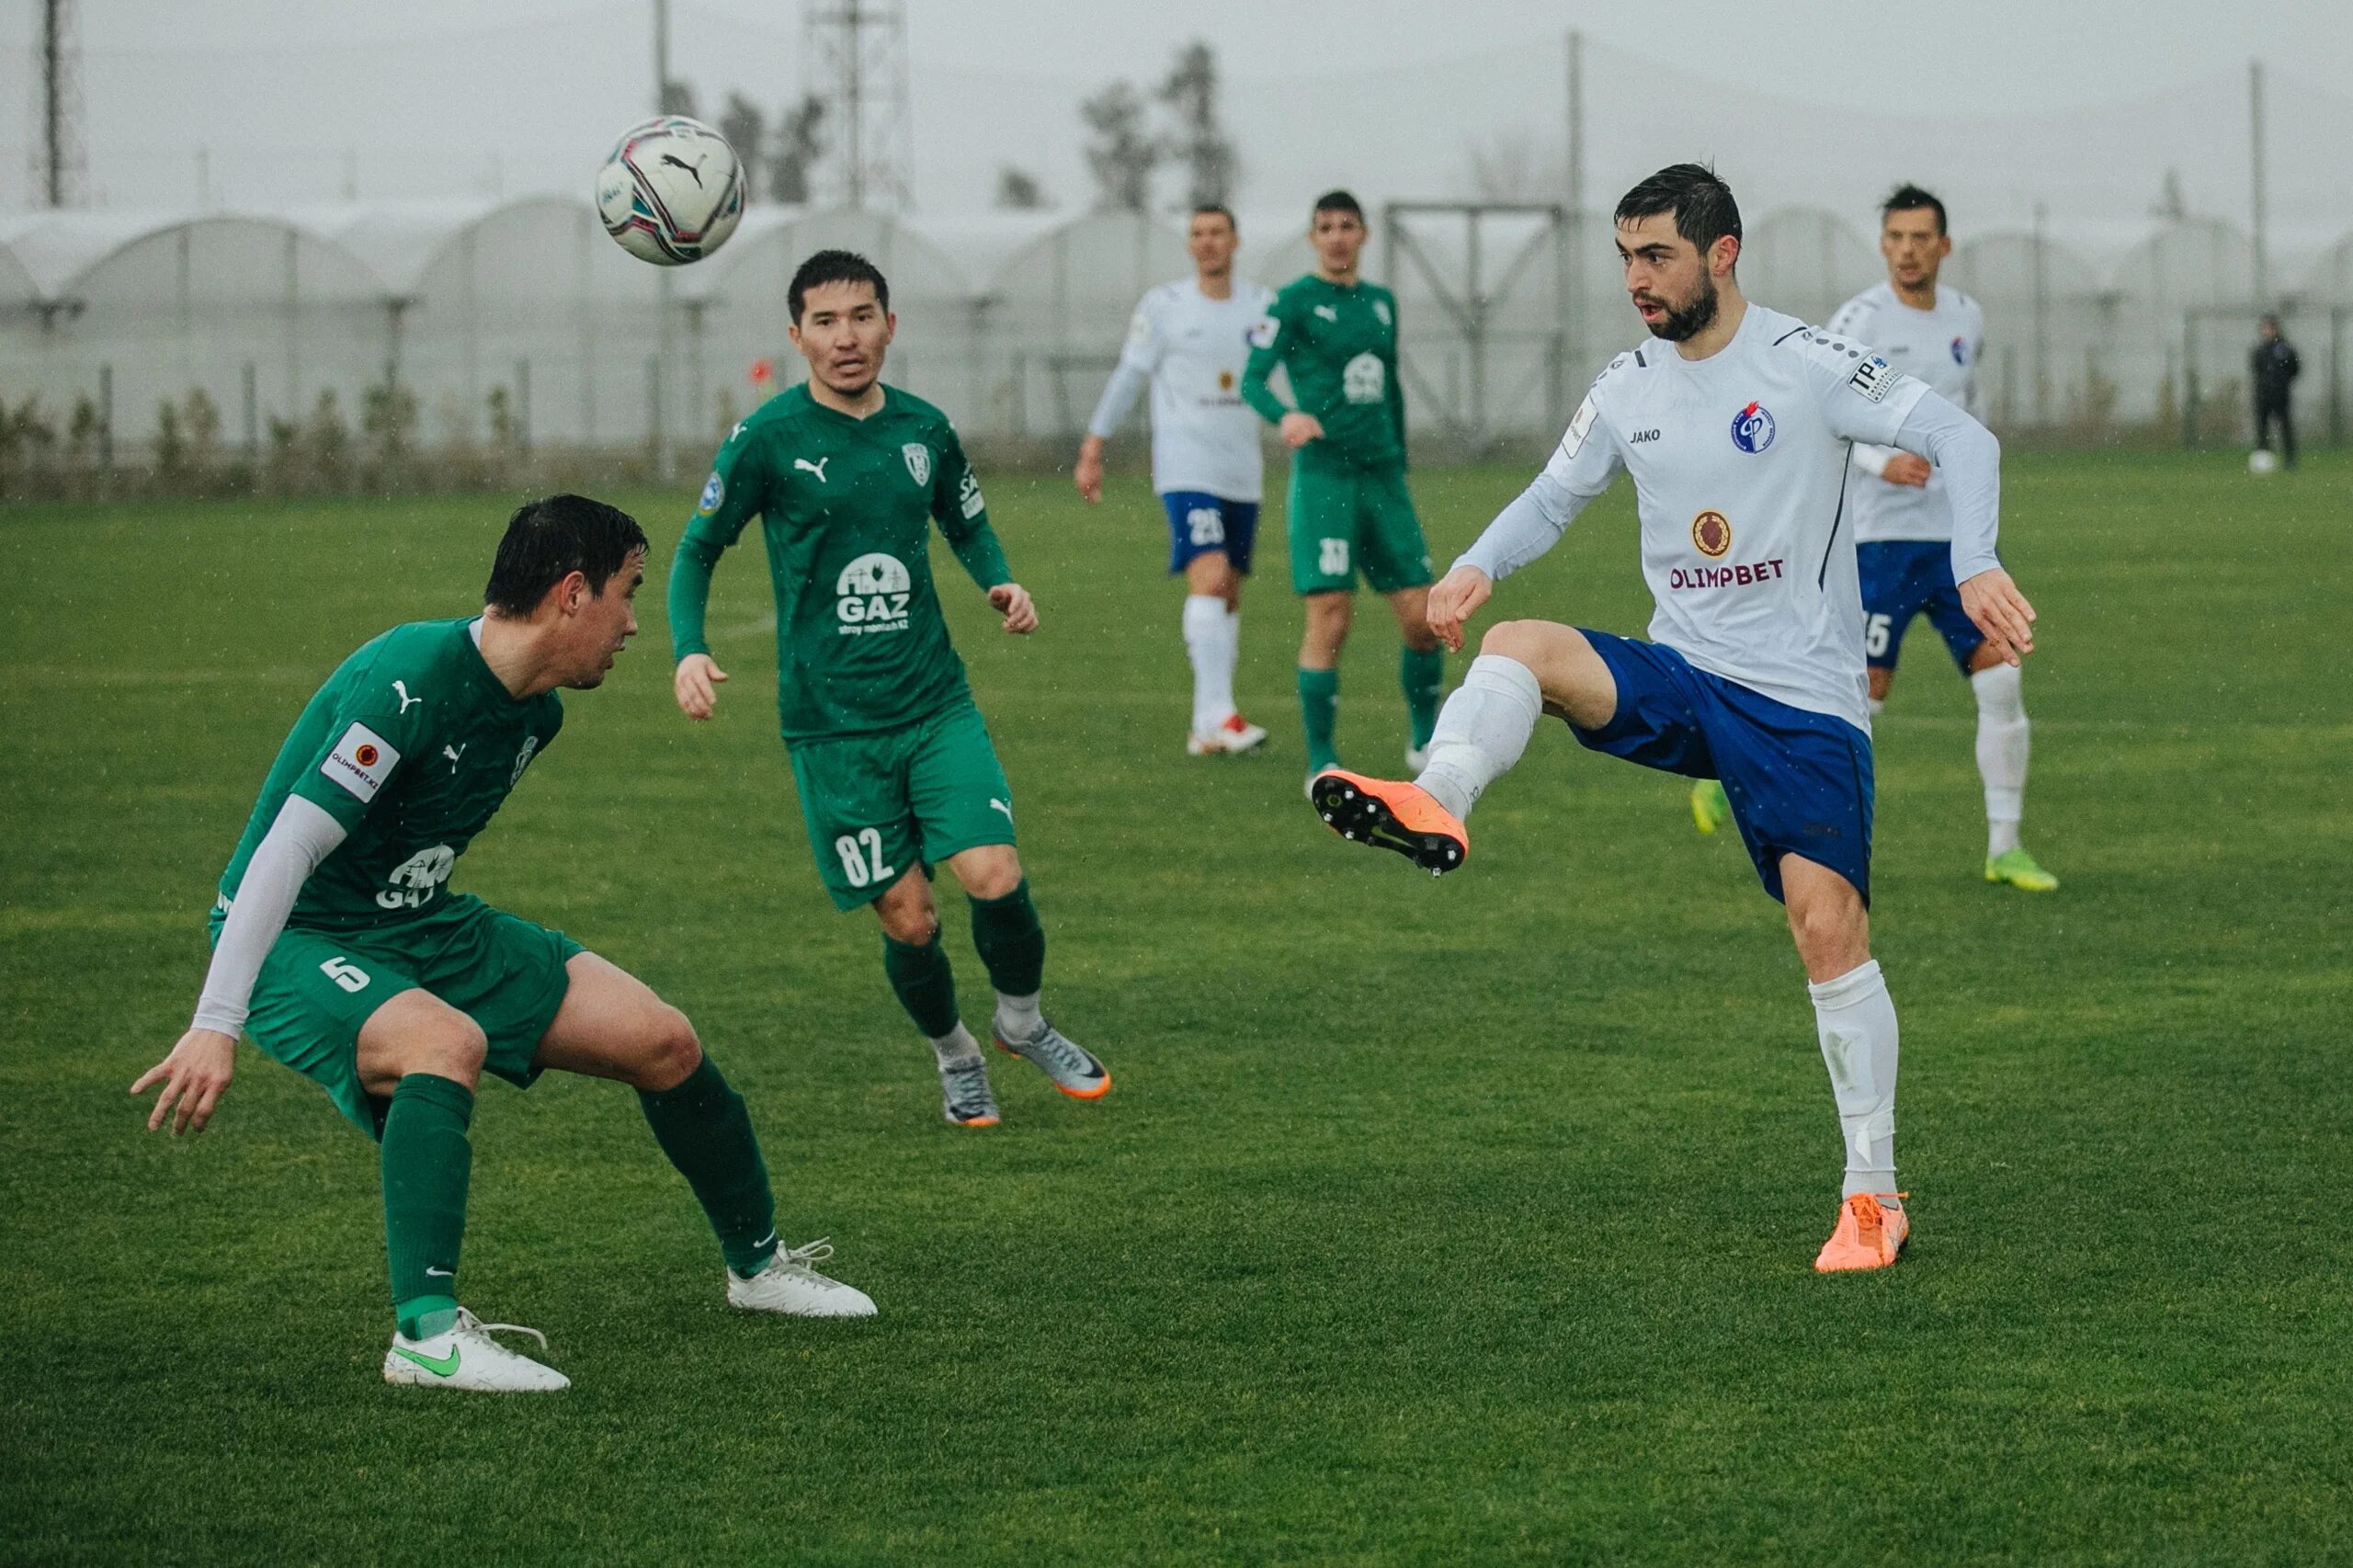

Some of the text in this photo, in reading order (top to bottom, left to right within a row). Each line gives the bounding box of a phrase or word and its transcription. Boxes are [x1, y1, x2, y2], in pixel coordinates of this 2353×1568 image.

[1630, 429, 1661, 444] JAKO
[1670, 559, 1783, 589] OLIMPBET
[836, 593, 910, 623] GAZ
[332, 753, 379, 790] OLIMPBET.KZ
[835, 826, 894, 888] 82
